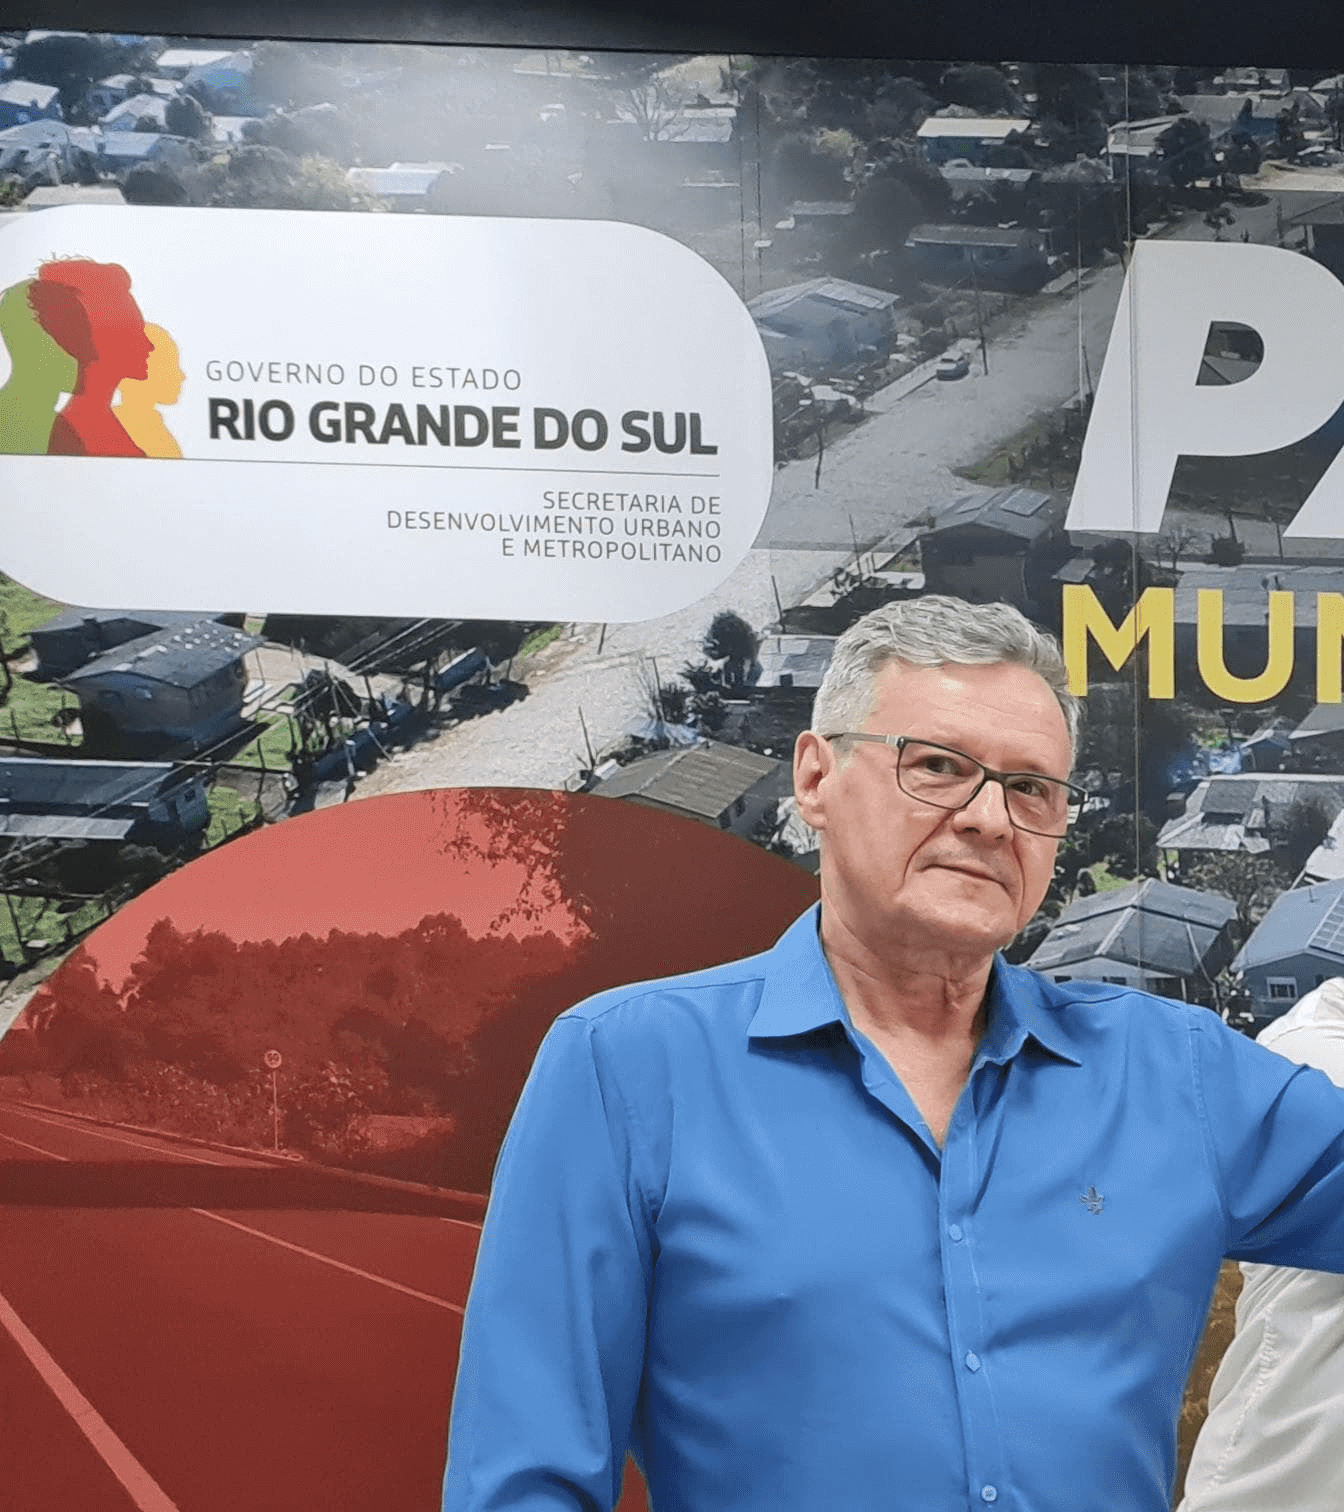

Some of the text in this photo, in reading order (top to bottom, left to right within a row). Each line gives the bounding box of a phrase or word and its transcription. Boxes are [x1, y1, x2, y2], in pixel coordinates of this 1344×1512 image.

[206, 359, 521, 391] GOVERNO DO ESTADO
[207, 397, 719, 456] RIO GRANDE DO SUL
[543, 490, 722, 515] SECRETARIA DE
[387, 510, 721, 539] DESENVOLVIMENTO URBANO
[502, 537, 721, 563] E METROPOLITANO
